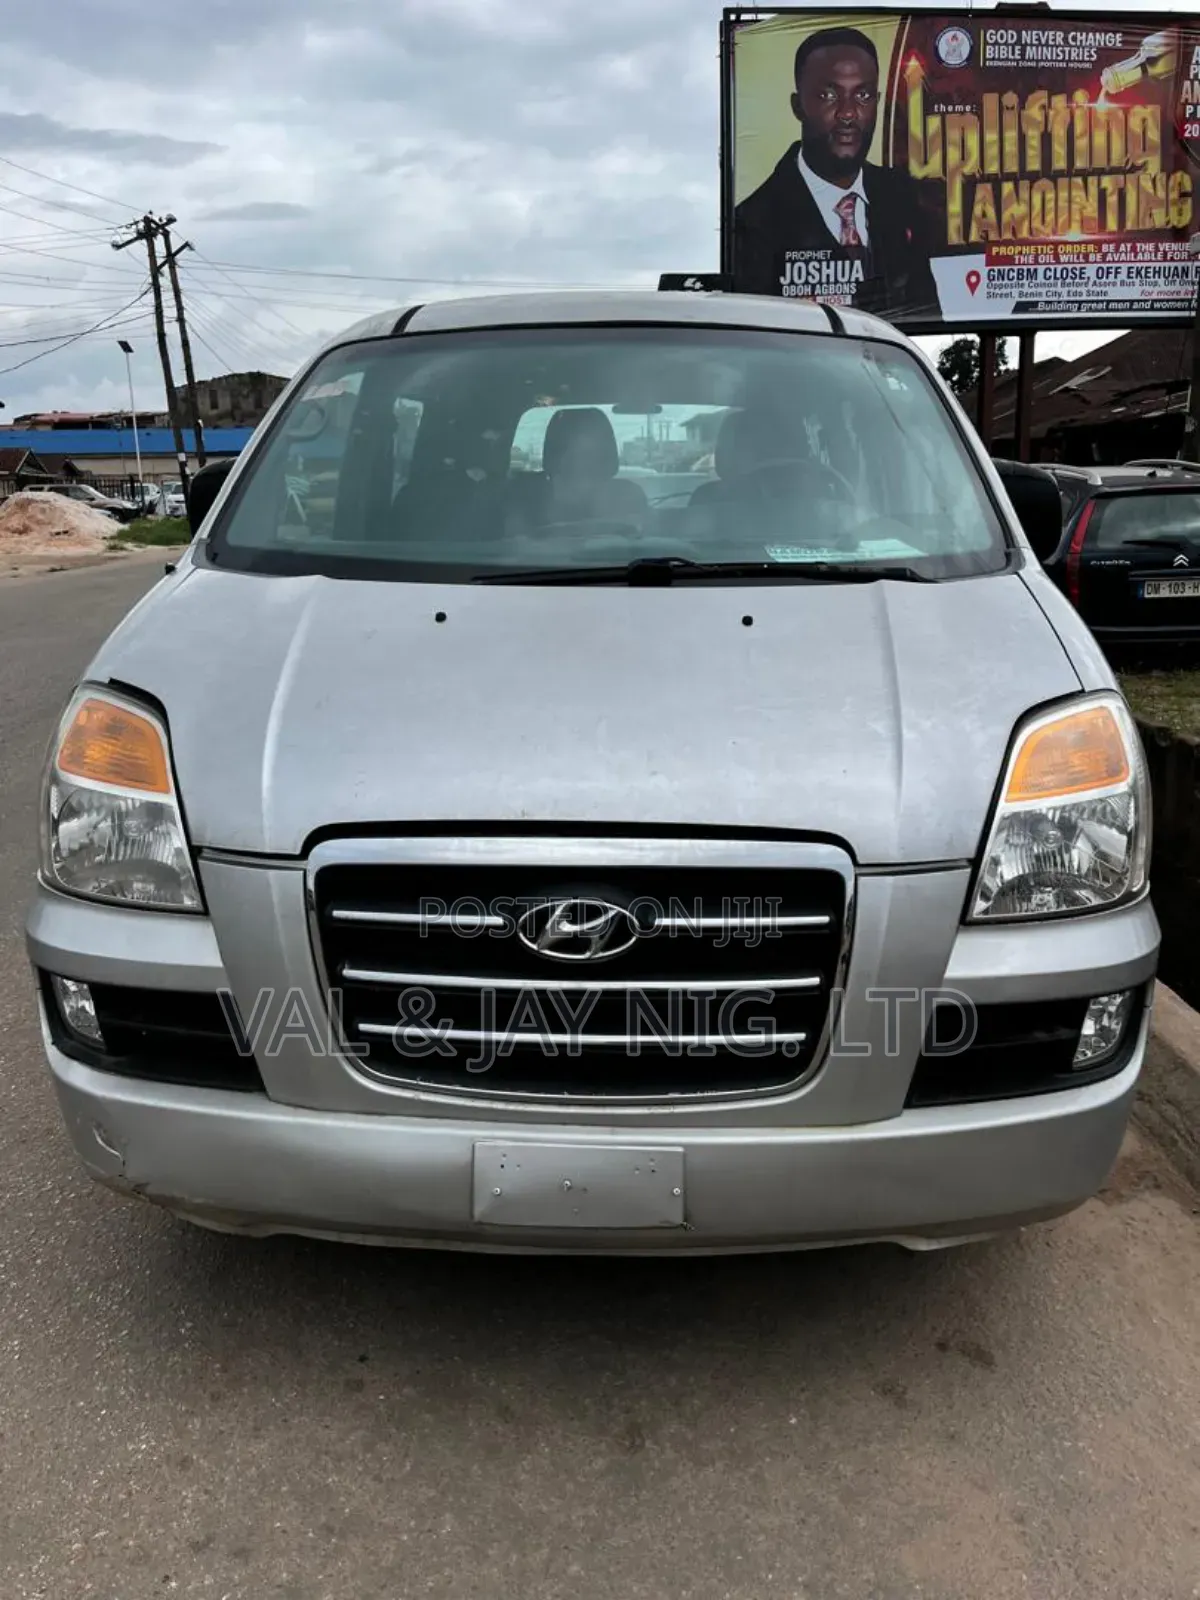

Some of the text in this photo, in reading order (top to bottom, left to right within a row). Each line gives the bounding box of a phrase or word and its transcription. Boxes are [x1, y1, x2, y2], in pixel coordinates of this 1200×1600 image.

[986, 30, 1122, 47] GOD NEVER CHANGE
[986, 45, 1097, 60] BIBLE MINISTRIES
[934, 103, 977, 113] theme:
[969, 171, 1193, 243] ANOINTING
[785, 250, 832, 260] PROPHET
[992, 242, 1191, 255] PROPHETIC ORDER: BE AT THE VENUE
[1014, 251, 1188, 264] THE OIL WILL BE AVAILABLE FOR
[779, 260, 864, 285] JOSHUA
[987, 268, 1038, 281] GNCBM
[1043, 267, 1091, 281] CLOSE,
[1096, 266, 1122, 280] OFF
[1127, 266, 1189, 280] EKEHUAN
[782, 283, 857, 297] OBOH AGBONS
[986, 281, 1025, 290] Opposite
[1018, 291, 1043, 299] Benin
[1067, 289, 1084, 297] Edo
[1085, 289, 1108, 297] State
[1140, 288, 1154, 297] for
[1156, 289, 1180, 297] more
[1081, 301, 1106, 311] great
[1132, 299, 1151, 309] and
[1153, 301, 1189, 309] women
